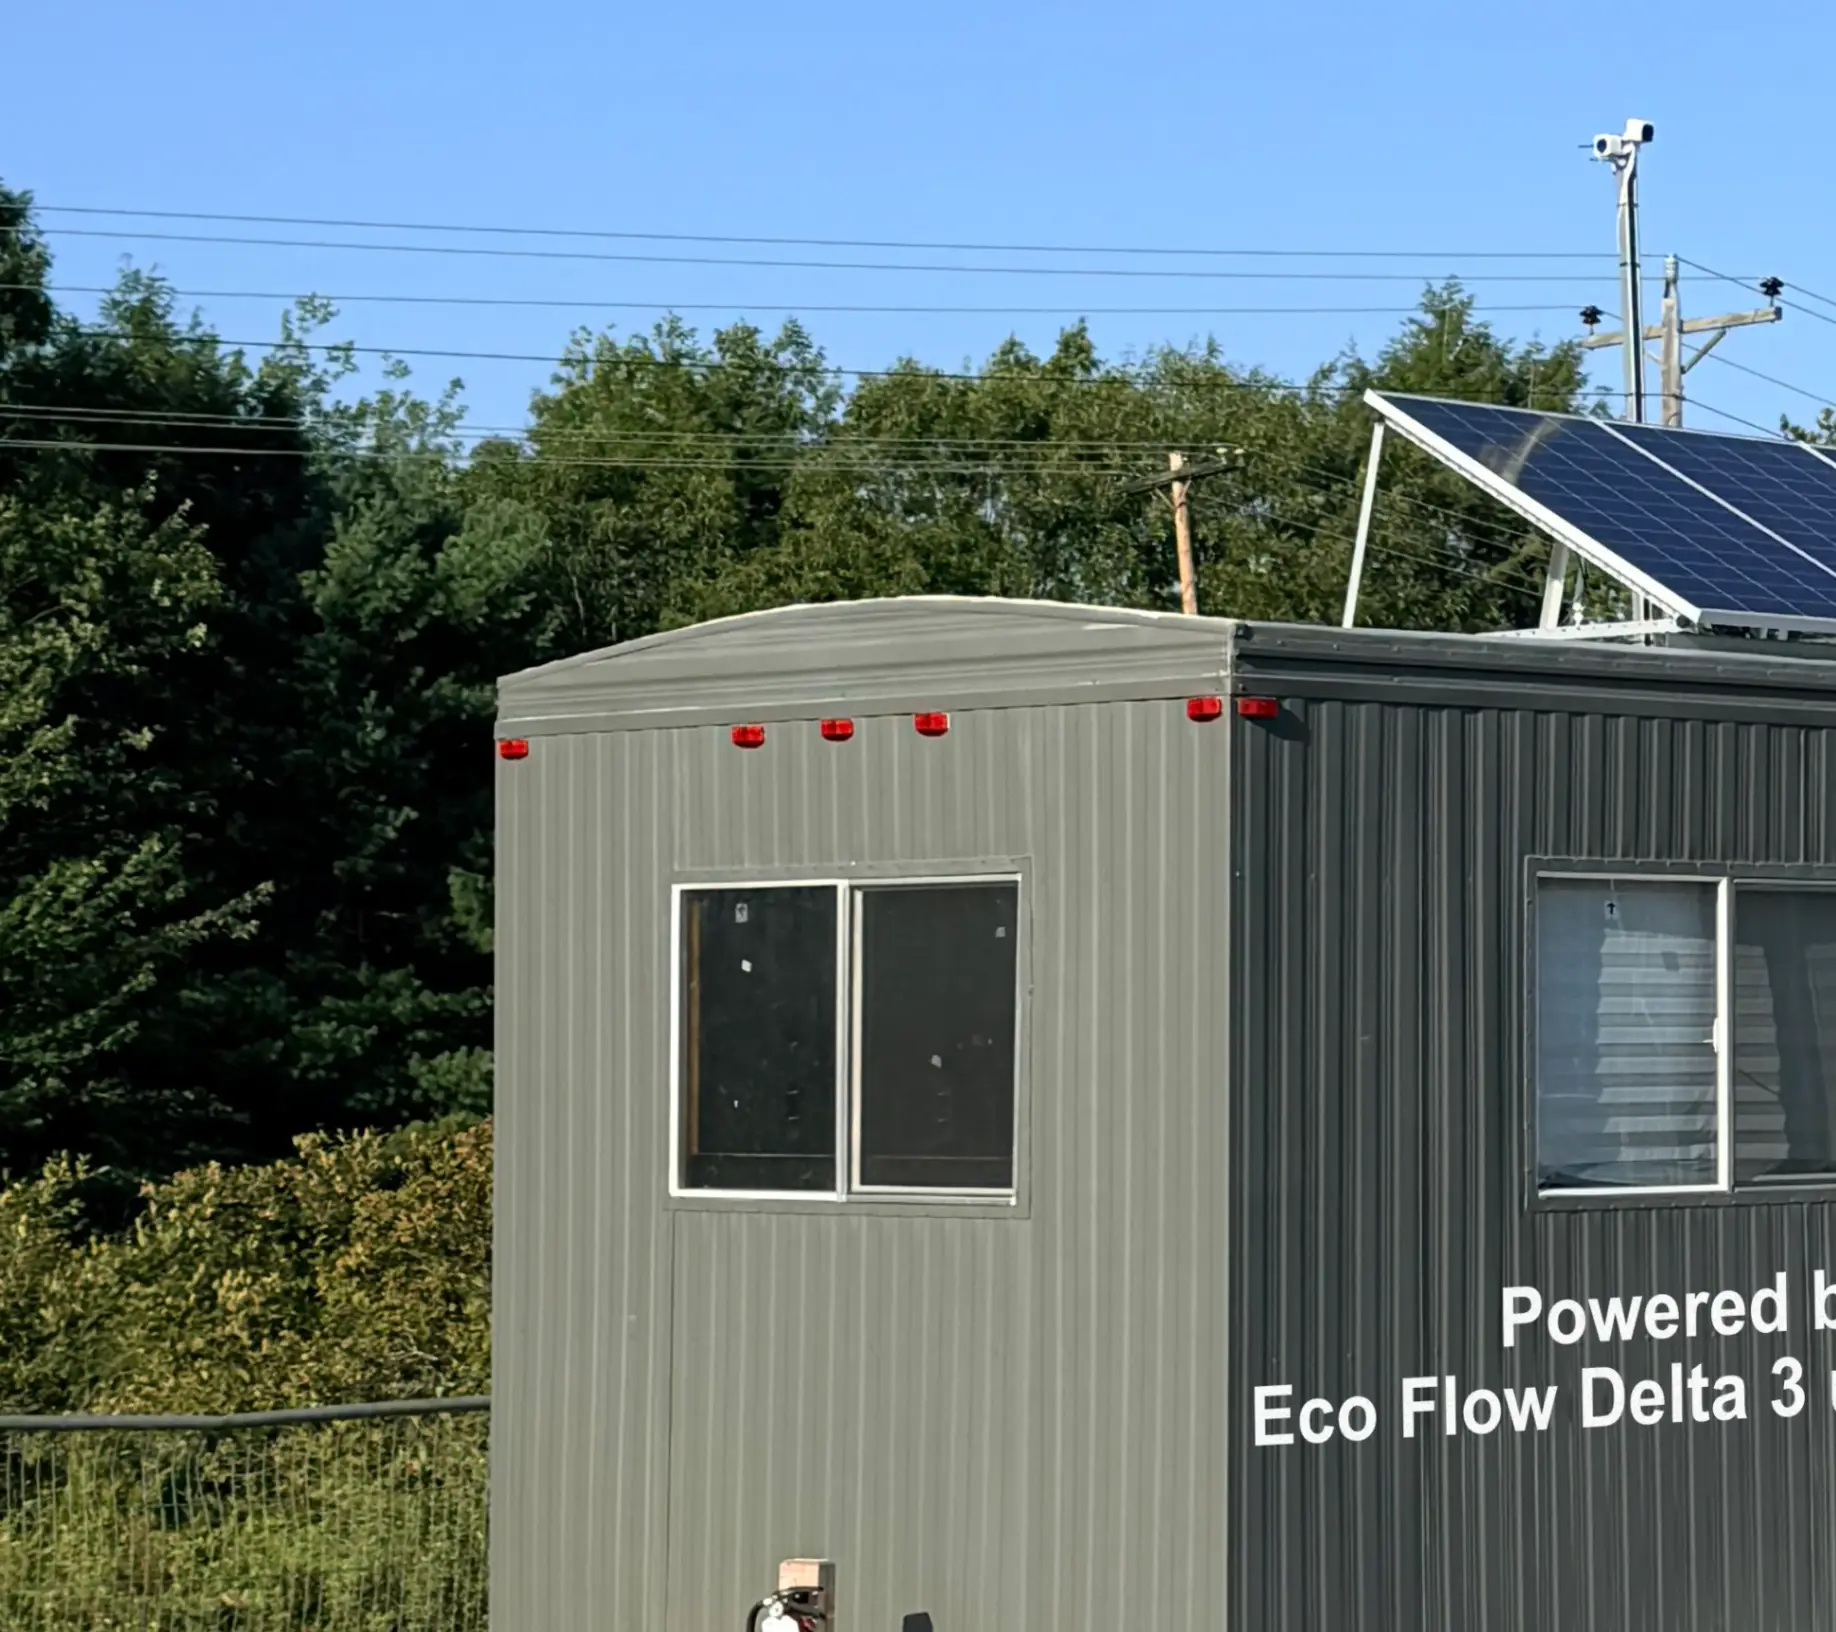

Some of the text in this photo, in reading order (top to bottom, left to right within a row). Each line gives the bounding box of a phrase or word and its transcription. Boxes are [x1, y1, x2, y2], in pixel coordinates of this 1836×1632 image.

[1502, 1271, 1788, 1347] Powered
[1254, 1384, 1377, 1446] Eco
[1402, 1375, 1558, 1438] Flow
[1582, 1362, 1747, 1428] Delta
[1771, 1356, 1805, 1418] 3
